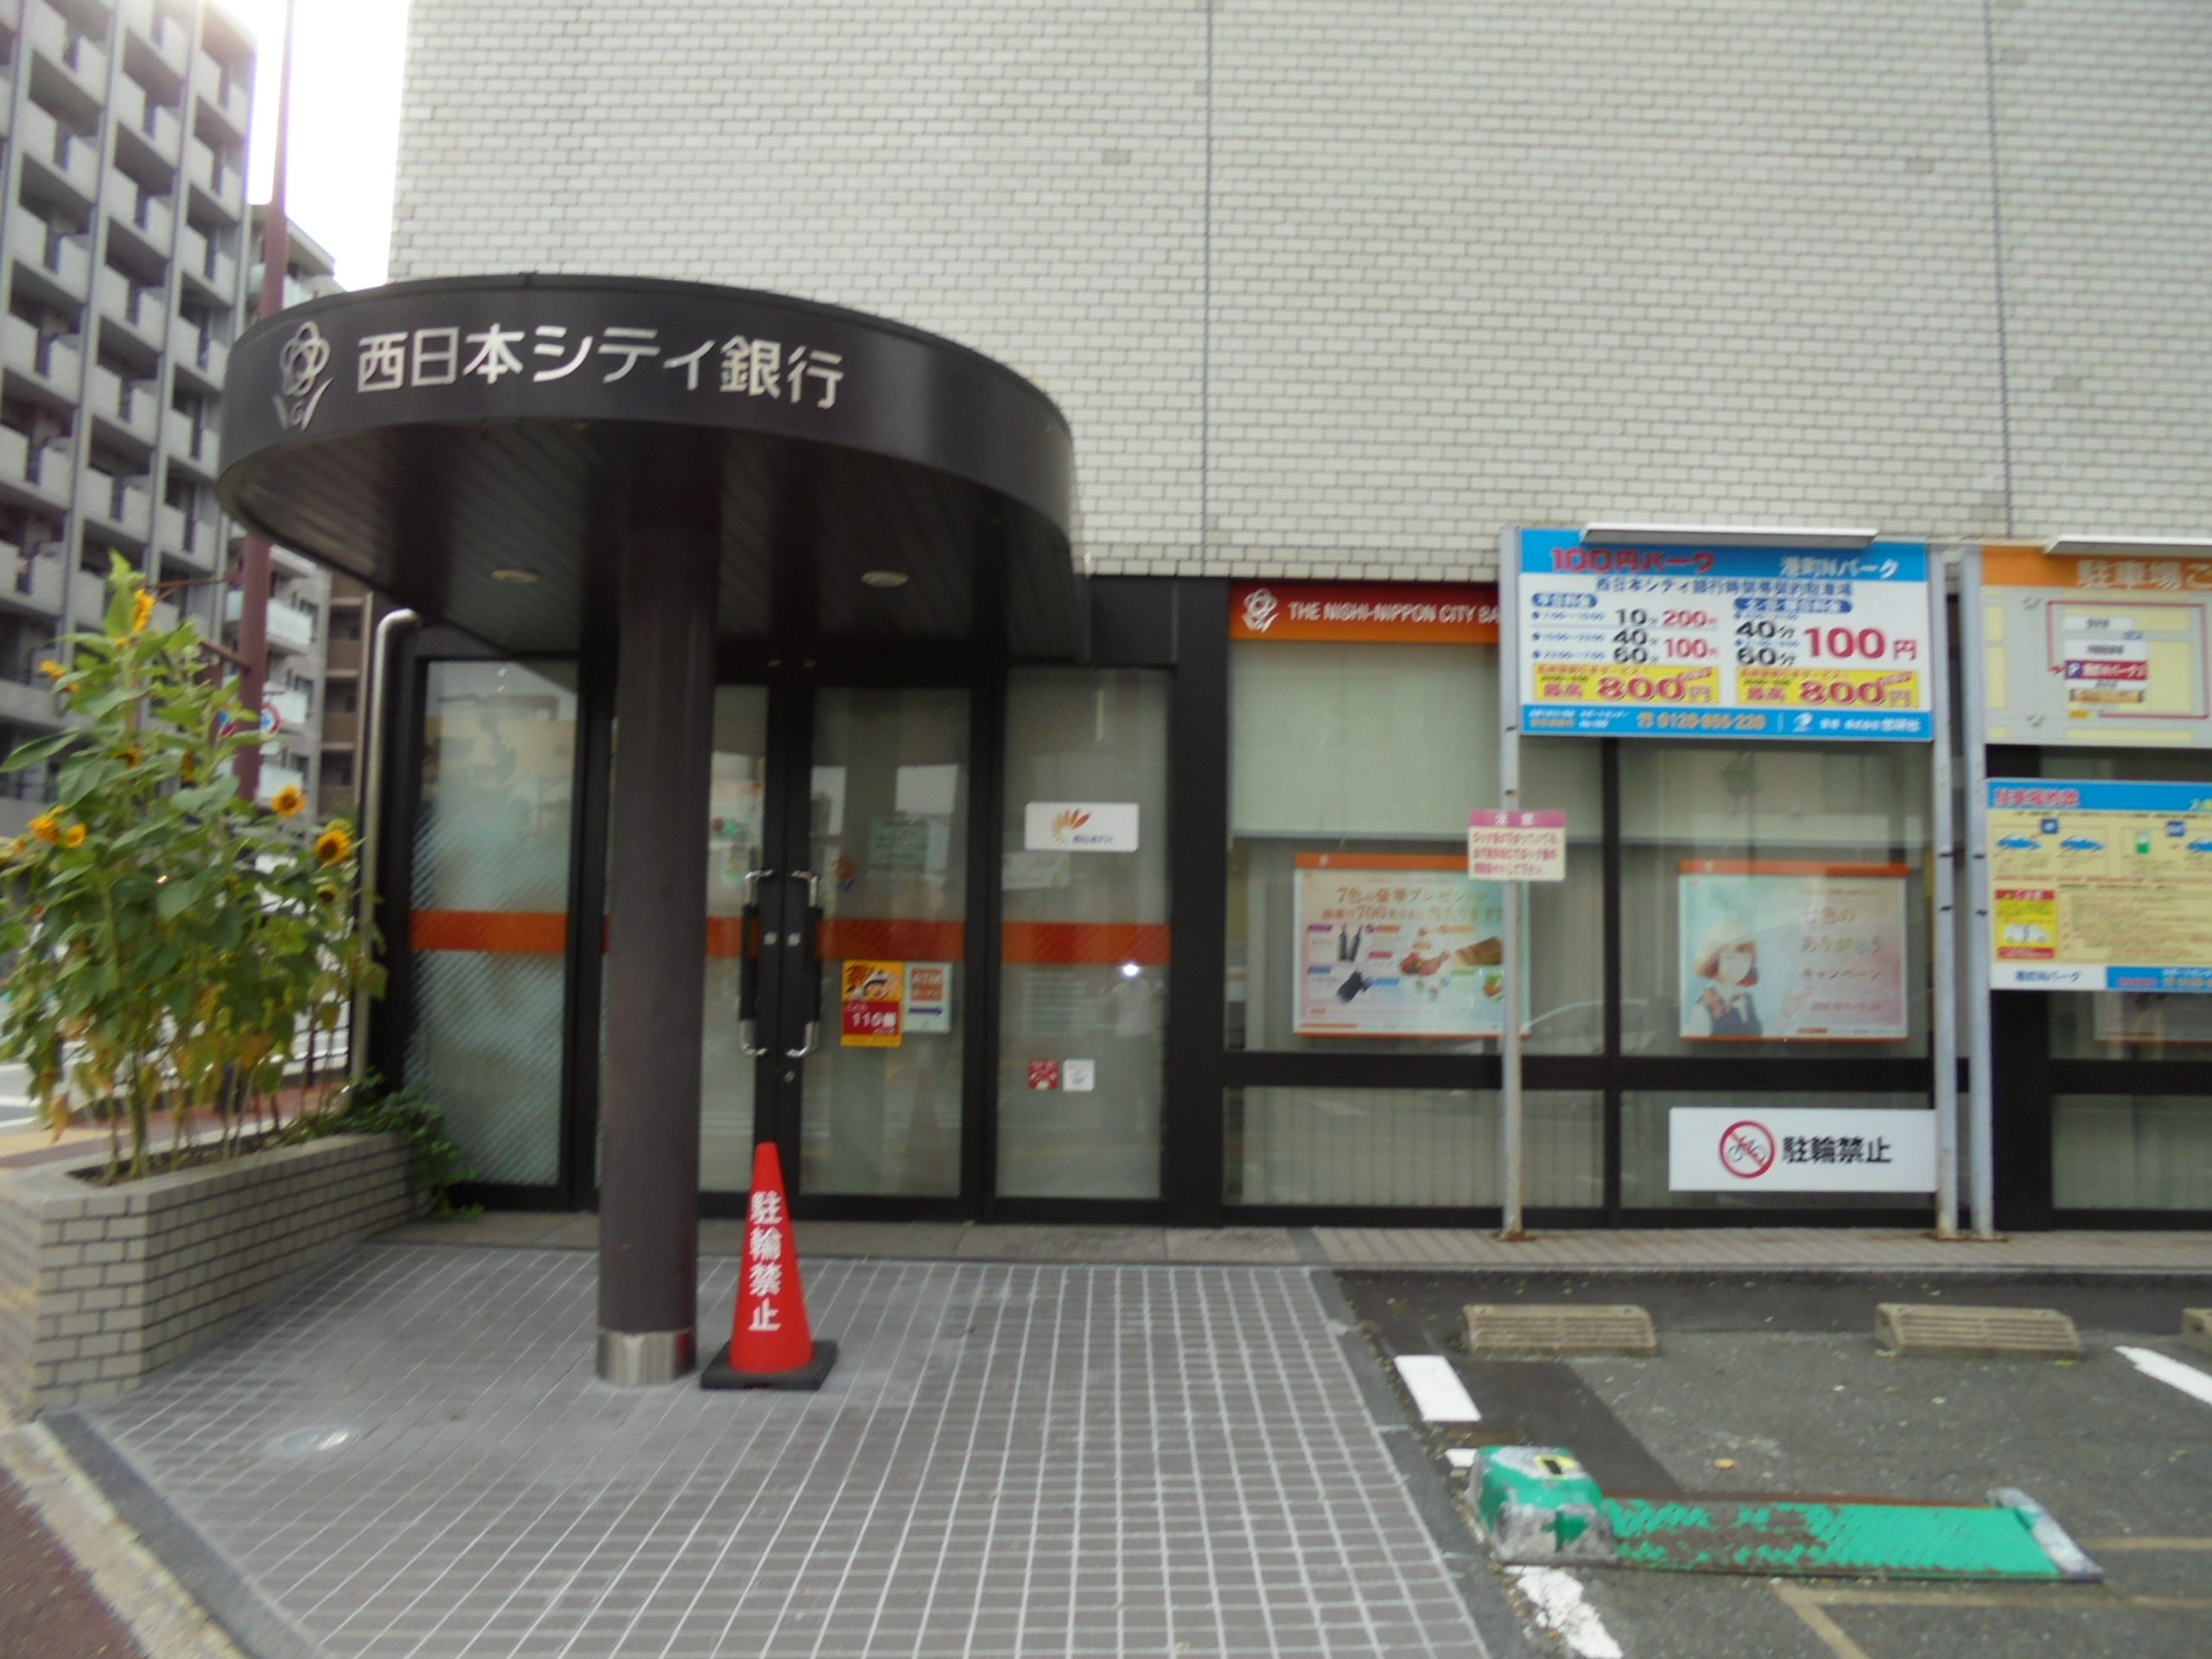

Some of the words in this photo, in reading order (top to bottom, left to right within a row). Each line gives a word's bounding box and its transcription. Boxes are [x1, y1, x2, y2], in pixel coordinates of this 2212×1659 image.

[357, 322, 845, 410] 西日本シティ銀行
[1550, 547, 1715, 574] 100円パーク
[1287, 601, 1321, 621] THE
[1323, 601, 1437, 623] NISHI-NIPPON
[1439, 603, 1478, 624] CITY
[1782, 1135, 1894, 1165] 駐輪禁止
[748, 1190, 783, 1332] 駐輪禁止
